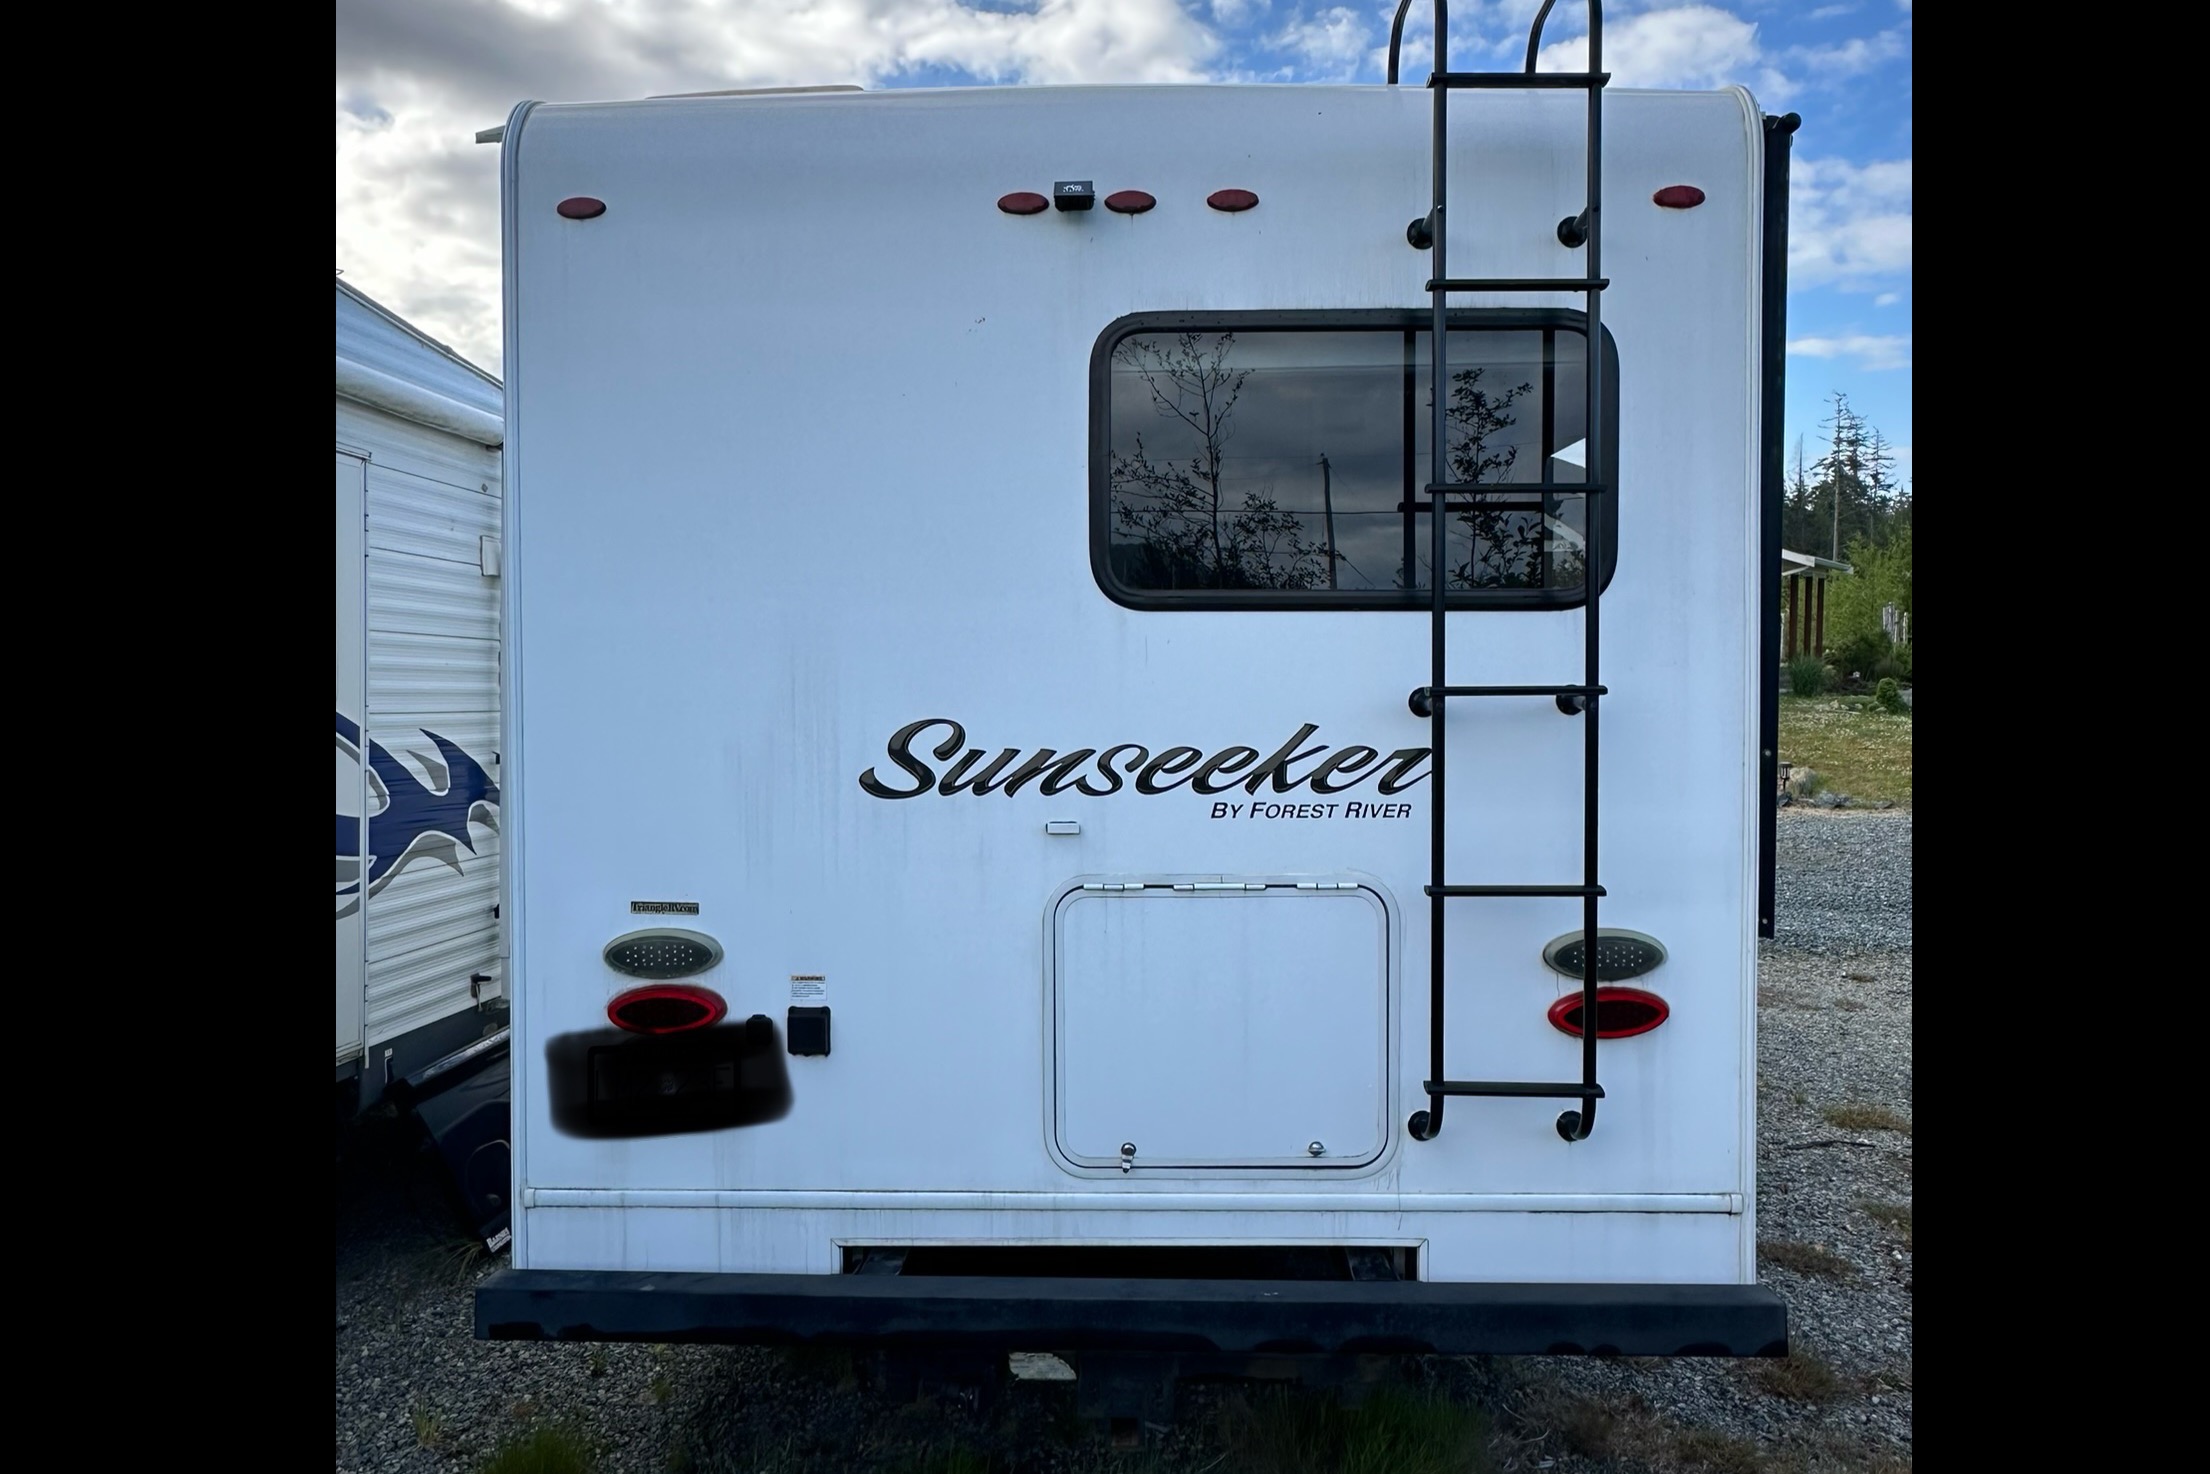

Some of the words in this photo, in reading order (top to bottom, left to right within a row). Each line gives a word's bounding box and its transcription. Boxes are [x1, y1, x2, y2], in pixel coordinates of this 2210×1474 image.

[859, 718, 1432, 798] Sunseeker
[1250, 802, 1339, 819] FOREST
[1345, 801, 1412, 819] RIVER
